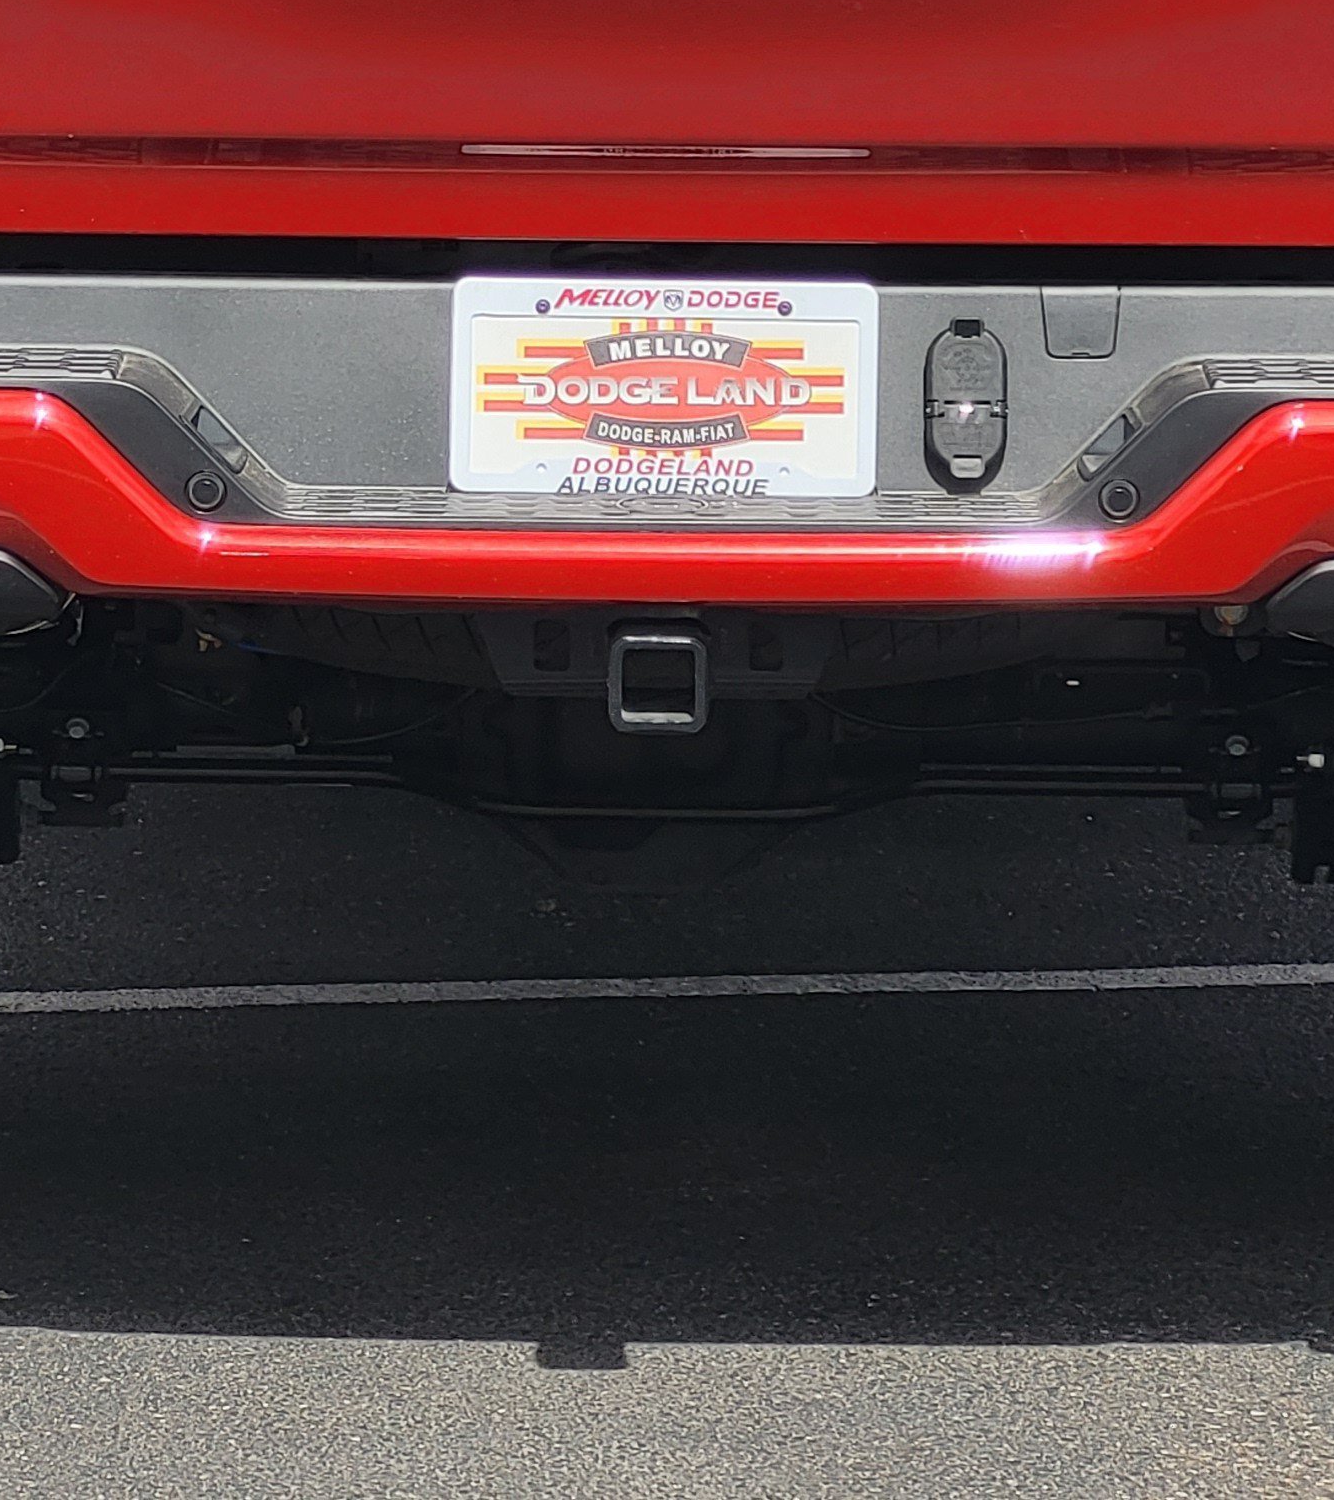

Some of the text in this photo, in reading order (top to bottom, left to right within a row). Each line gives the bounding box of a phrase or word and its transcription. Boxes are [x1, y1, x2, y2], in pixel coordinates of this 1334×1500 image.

[554, 289, 780, 310] MELLOY DODGE
[607, 336, 731, 363] MELLOY
[517, 374, 812, 407] DODGE LAND
[573, 457, 754, 478] DODGELAND
[556, 476, 769, 497] ALBUQUERQUE
